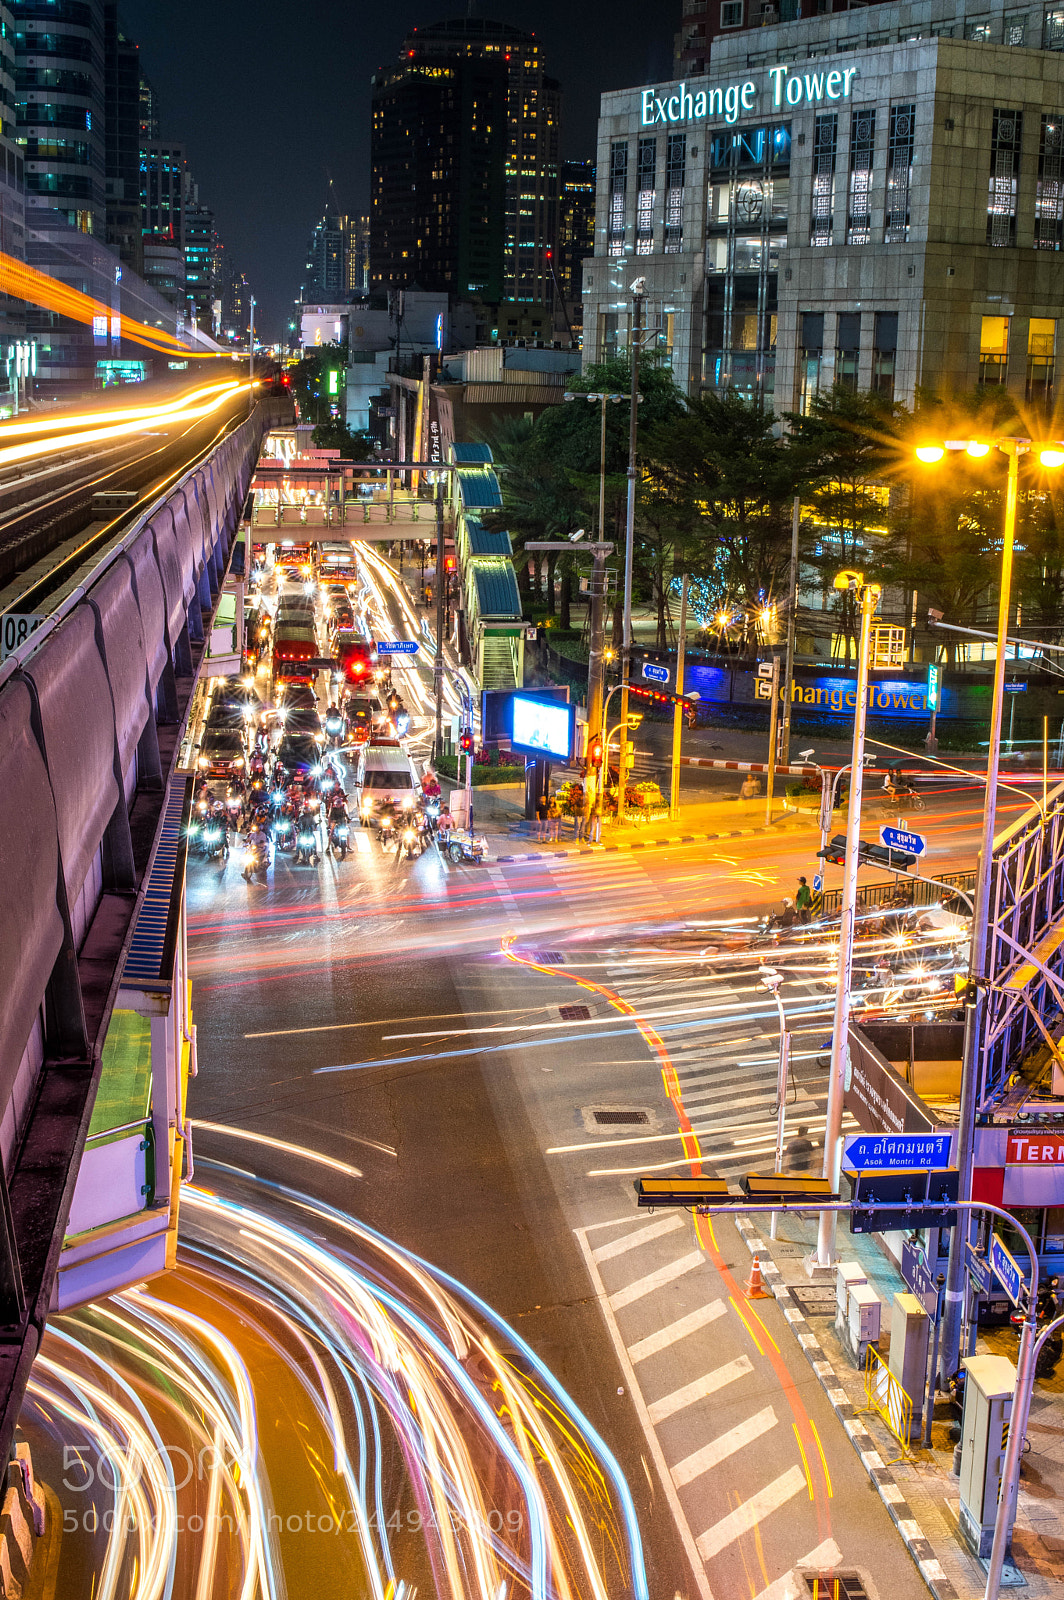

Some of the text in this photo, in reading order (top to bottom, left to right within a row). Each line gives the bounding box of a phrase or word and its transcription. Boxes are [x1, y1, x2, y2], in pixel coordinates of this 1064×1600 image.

[641, 65, 856, 126] Exchange Tower
[859, 1138, 944, 1155] ถ. อโศกมนตรี
[864, 1158, 934, 1166] Asok Montri Rd.
